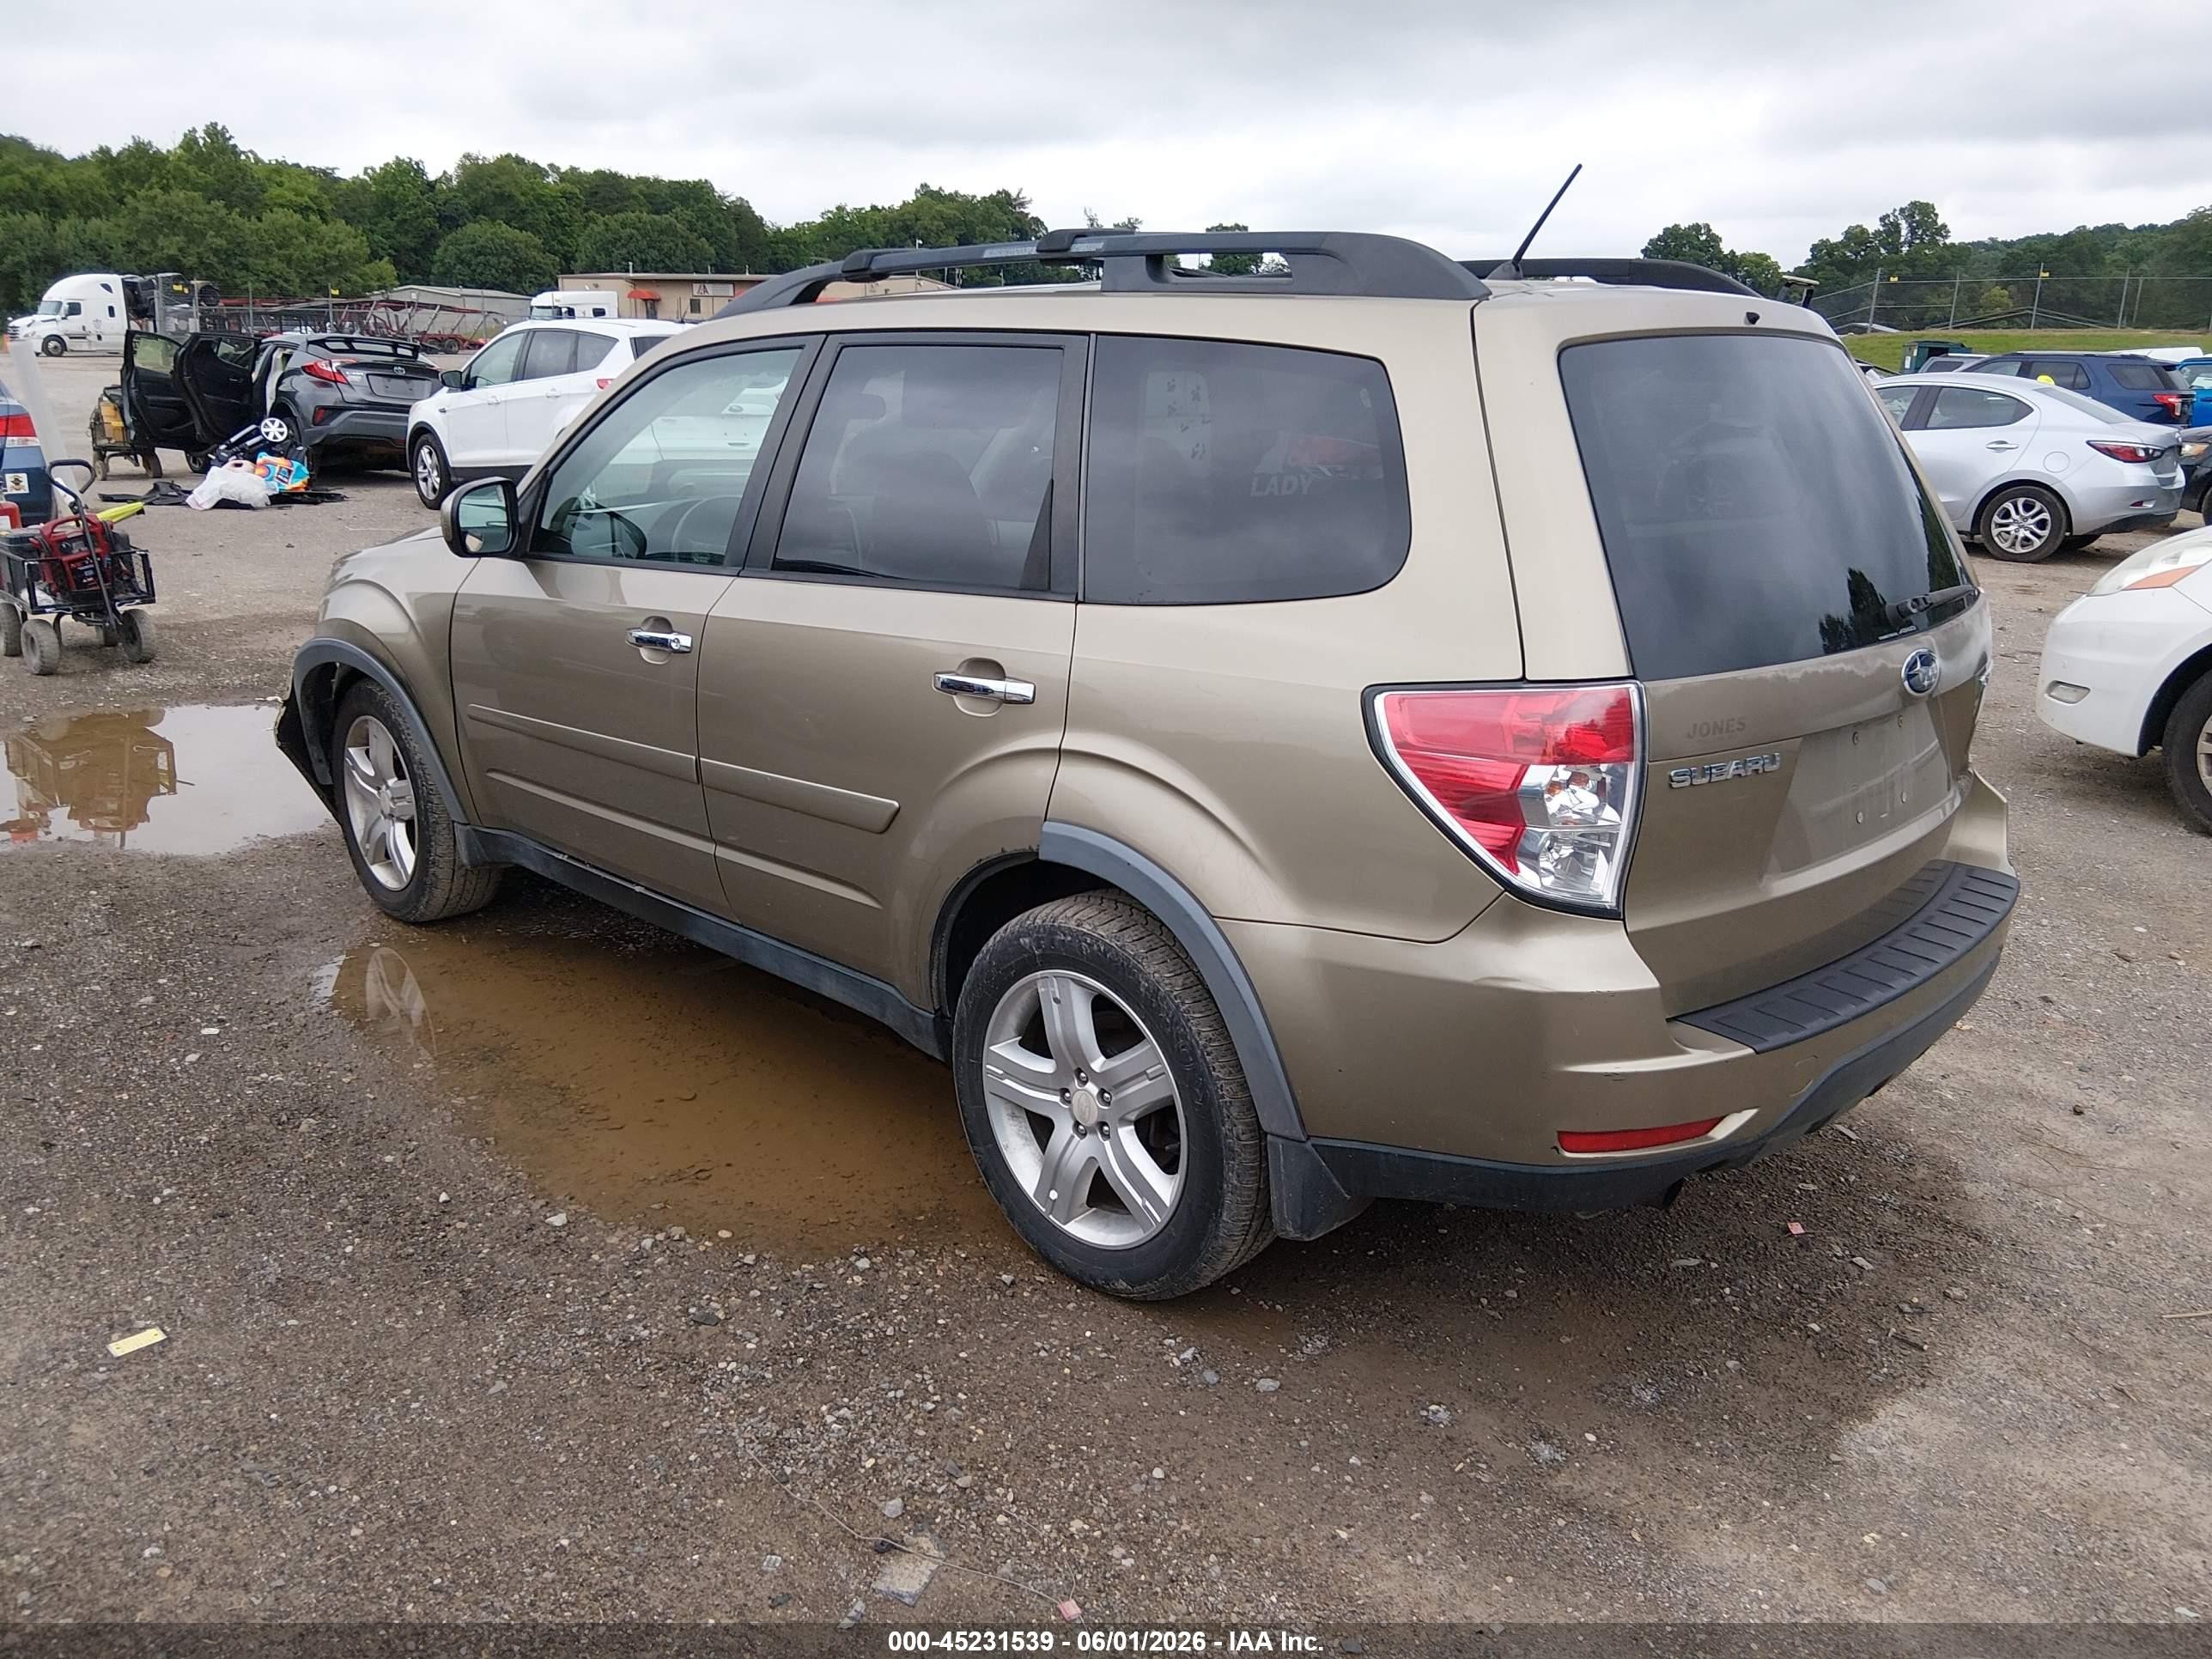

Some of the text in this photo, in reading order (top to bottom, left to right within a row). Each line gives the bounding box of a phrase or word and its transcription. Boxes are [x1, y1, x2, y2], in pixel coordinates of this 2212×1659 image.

[1249, 473, 1314, 497] LADY
[1686, 716, 1746, 739] JONES
[1668, 752, 1781, 789] SUBARU
